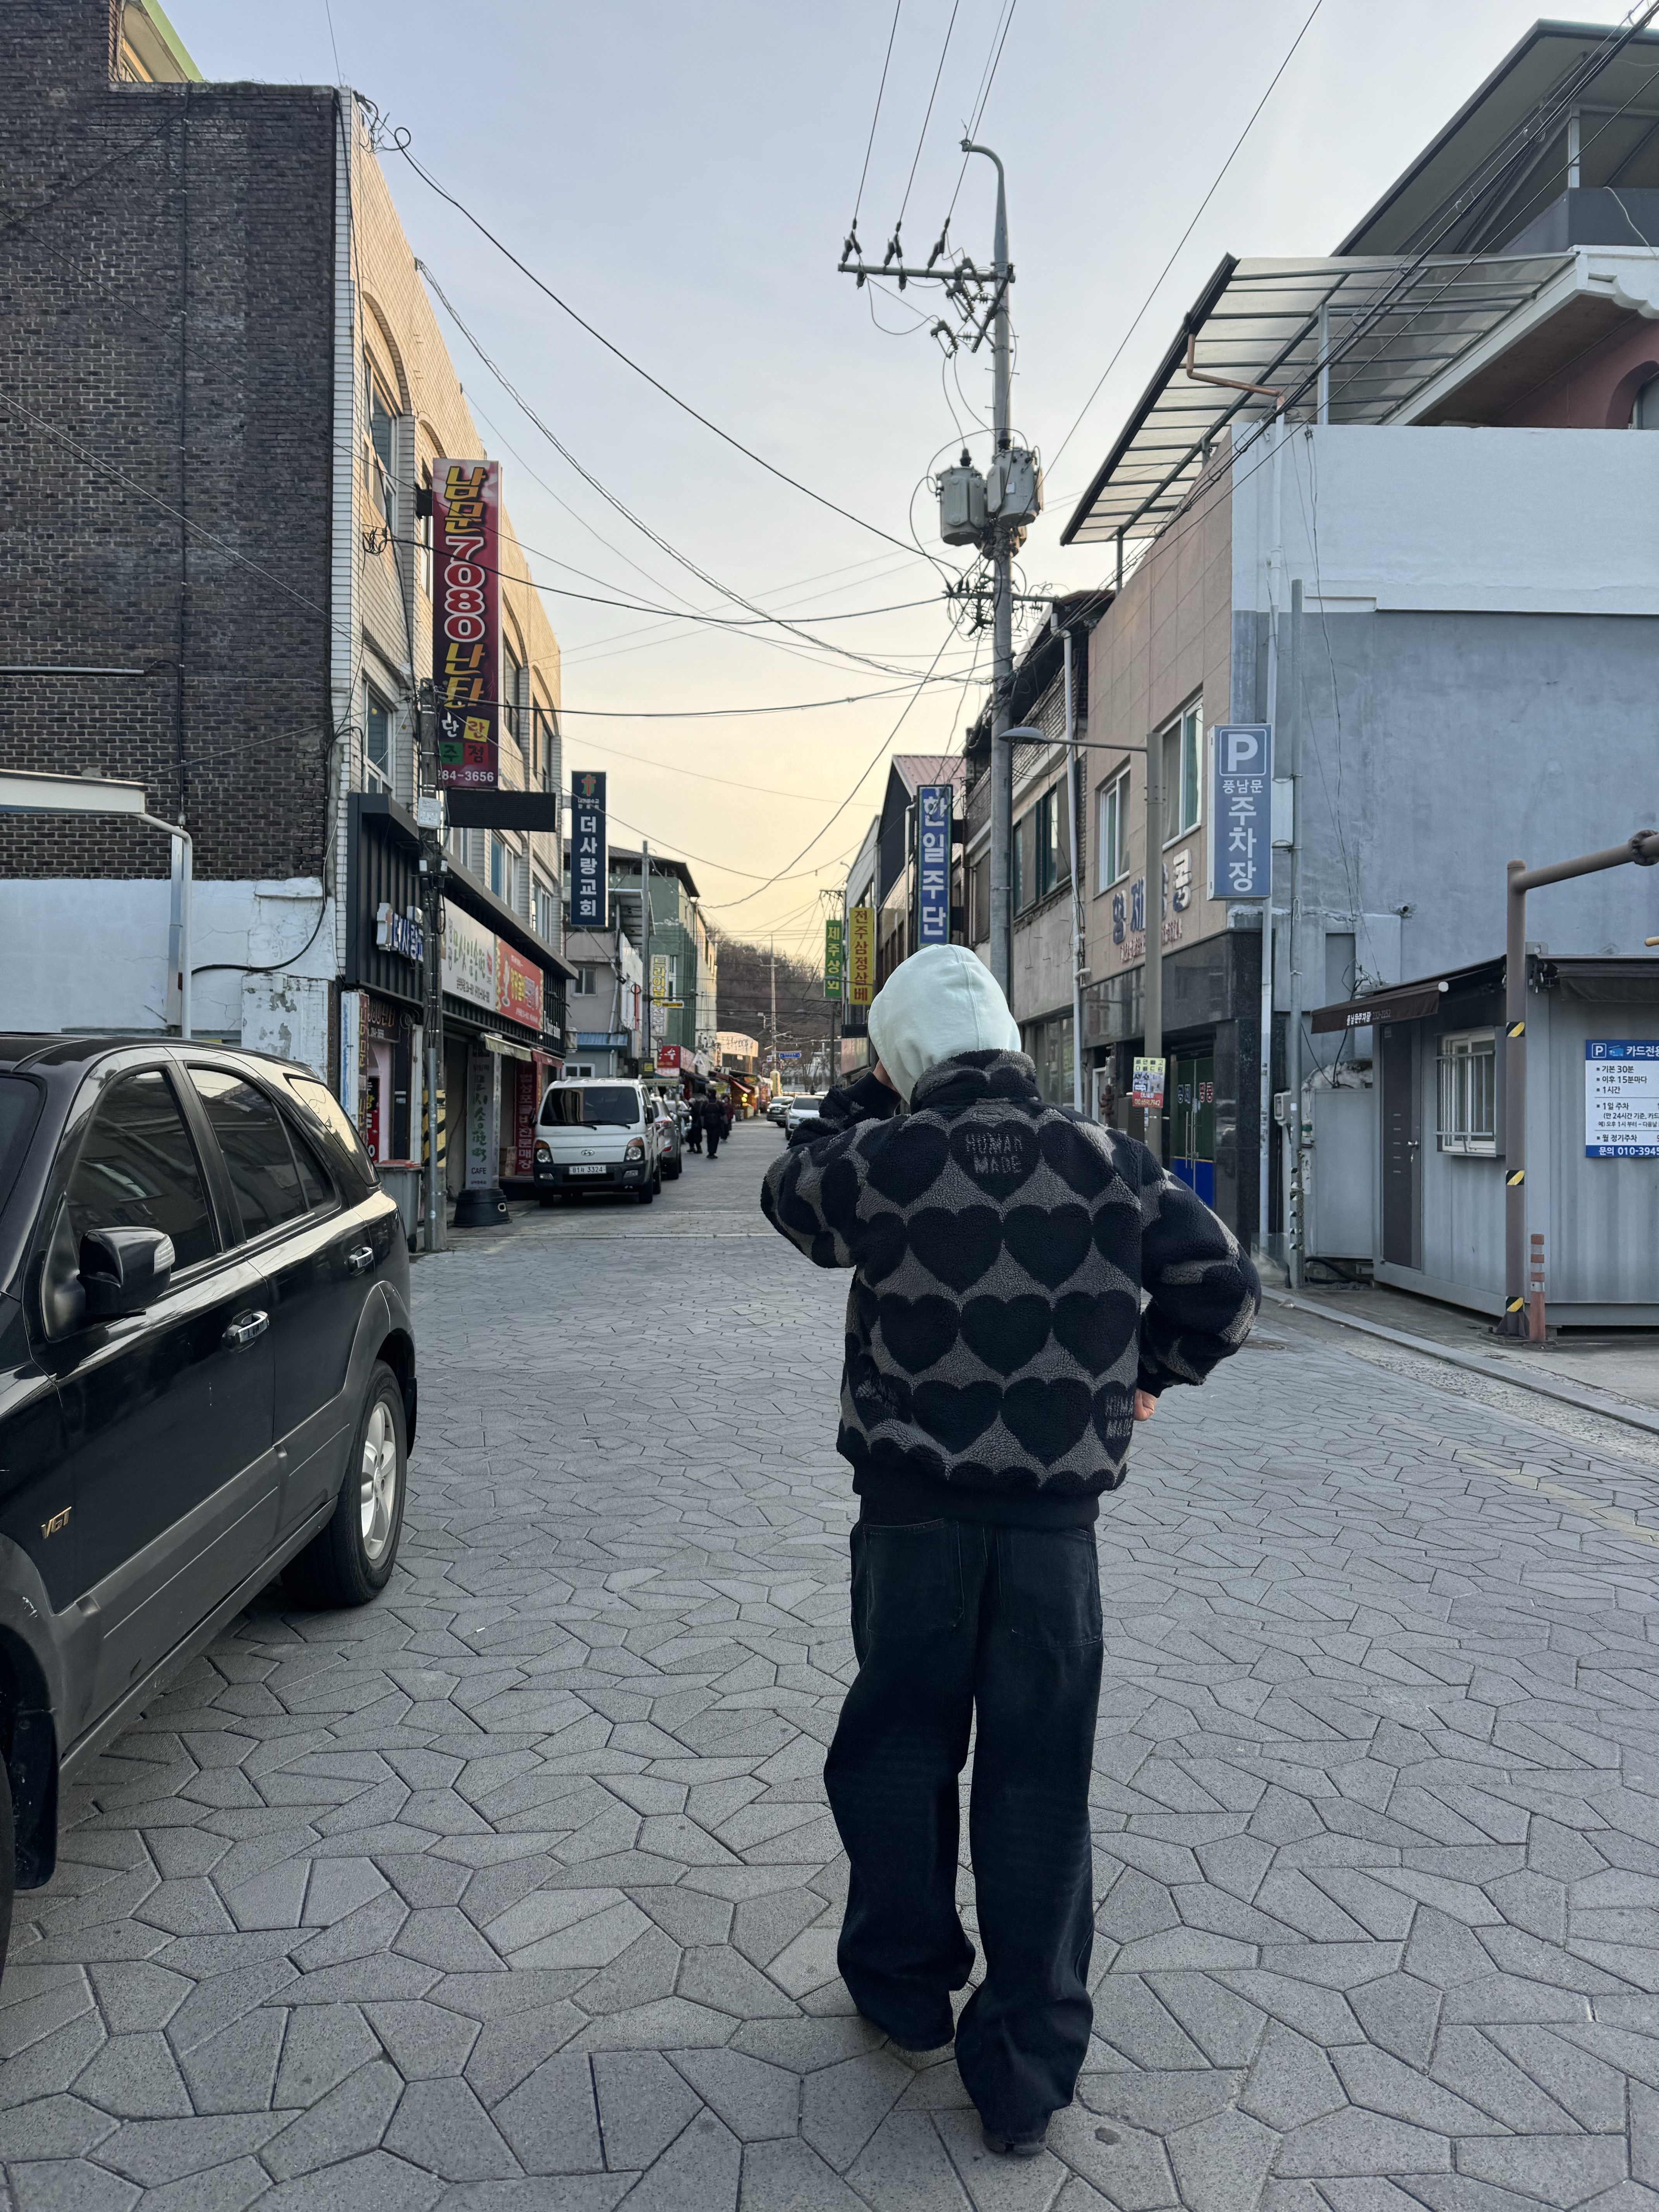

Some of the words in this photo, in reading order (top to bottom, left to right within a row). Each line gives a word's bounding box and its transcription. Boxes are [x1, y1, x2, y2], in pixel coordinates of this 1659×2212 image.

[444, 536, 485, 642] 7080
[1228, 734, 1258, 771] P
[1223, 780, 1263, 794] 풍남문
[1228, 797, 1257, 891] 주차장
[580, 816, 598, 916] 더사랑교회
[922, 796, 947, 935] 한일주단
[1595, 1046, 1603, 1056] P
[966, 1132, 1023, 1154] HUMAN
[1599, 1146, 1614, 1156] 문의
[1602, 1134, 1609, 1142] 월
[974, 1155, 1022, 1174] MADE
[41, 1506, 72, 1539] VGT
